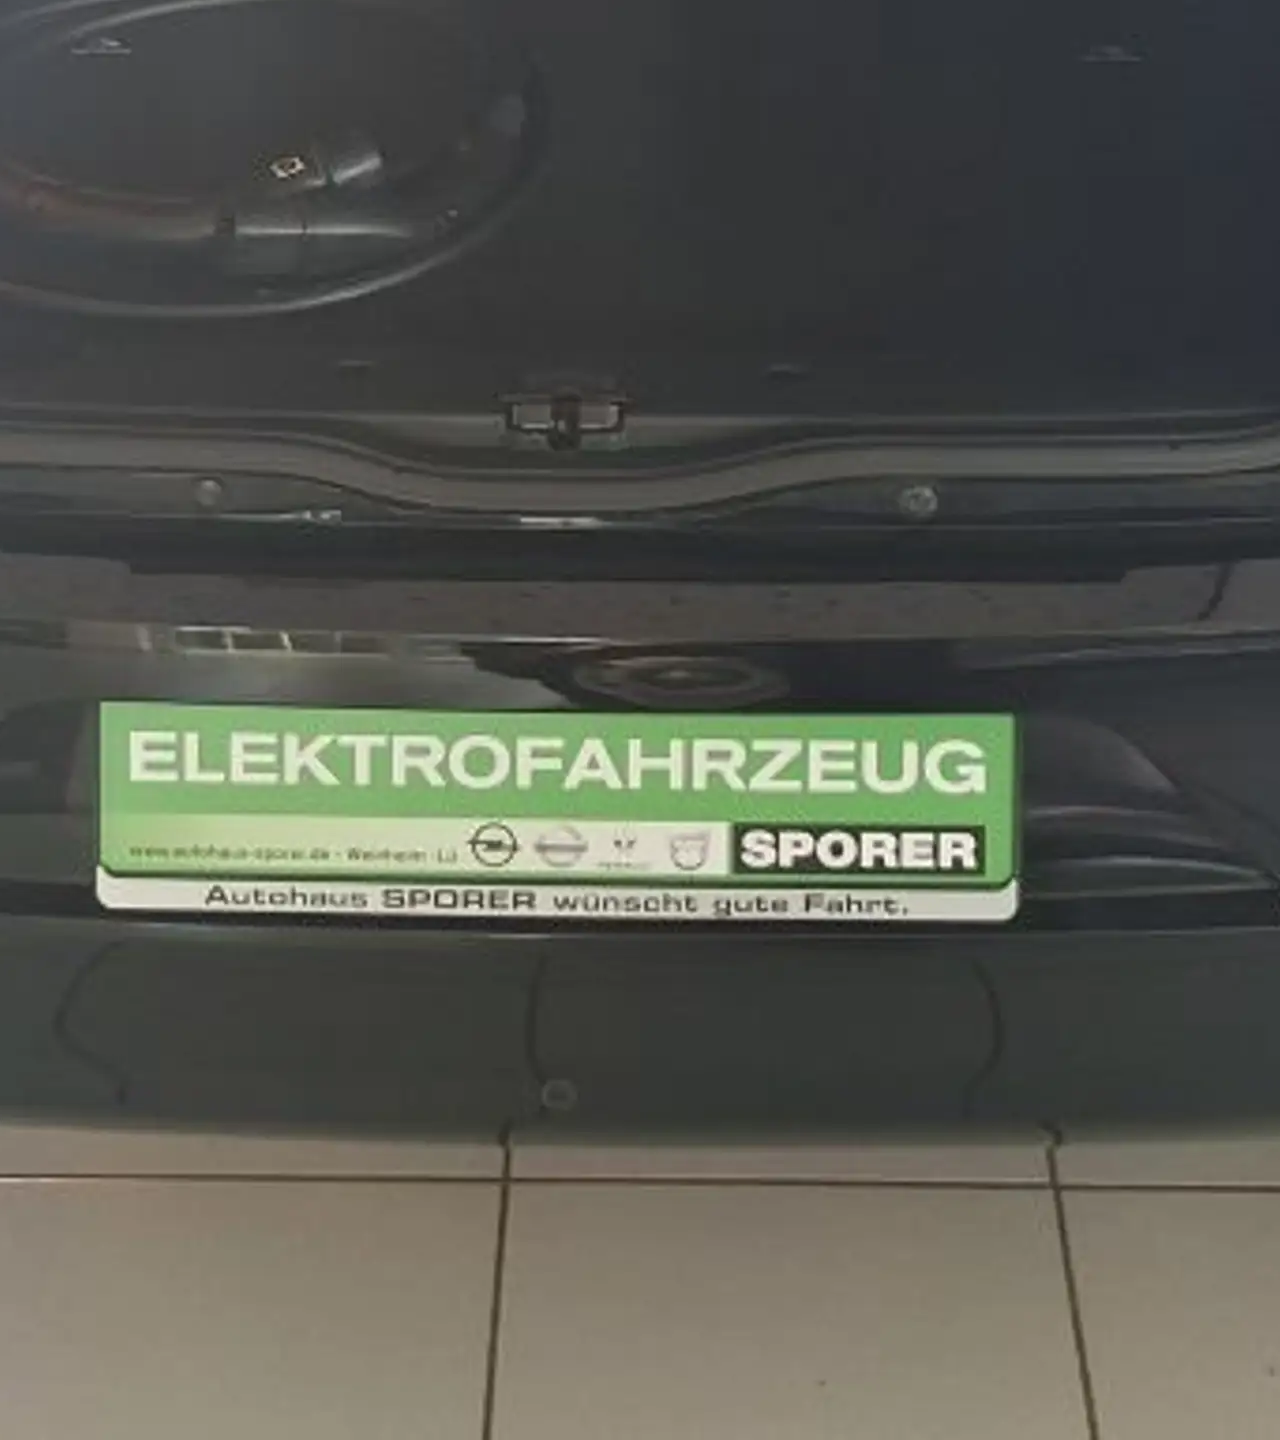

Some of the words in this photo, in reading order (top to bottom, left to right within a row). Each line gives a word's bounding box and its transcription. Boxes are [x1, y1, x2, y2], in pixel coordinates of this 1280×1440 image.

[128, 729, 987, 795] ELEKTROFAHRZEUG
[739, 830, 979, 869] SPORER
[204, 885, 369, 908] Autohaus
[380, 888, 538, 910] SPORER
[552, 891, 698, 914] wünscht
[712, 896, 789, 917] gute
[803, 893, 910, 915] Fahrt.
